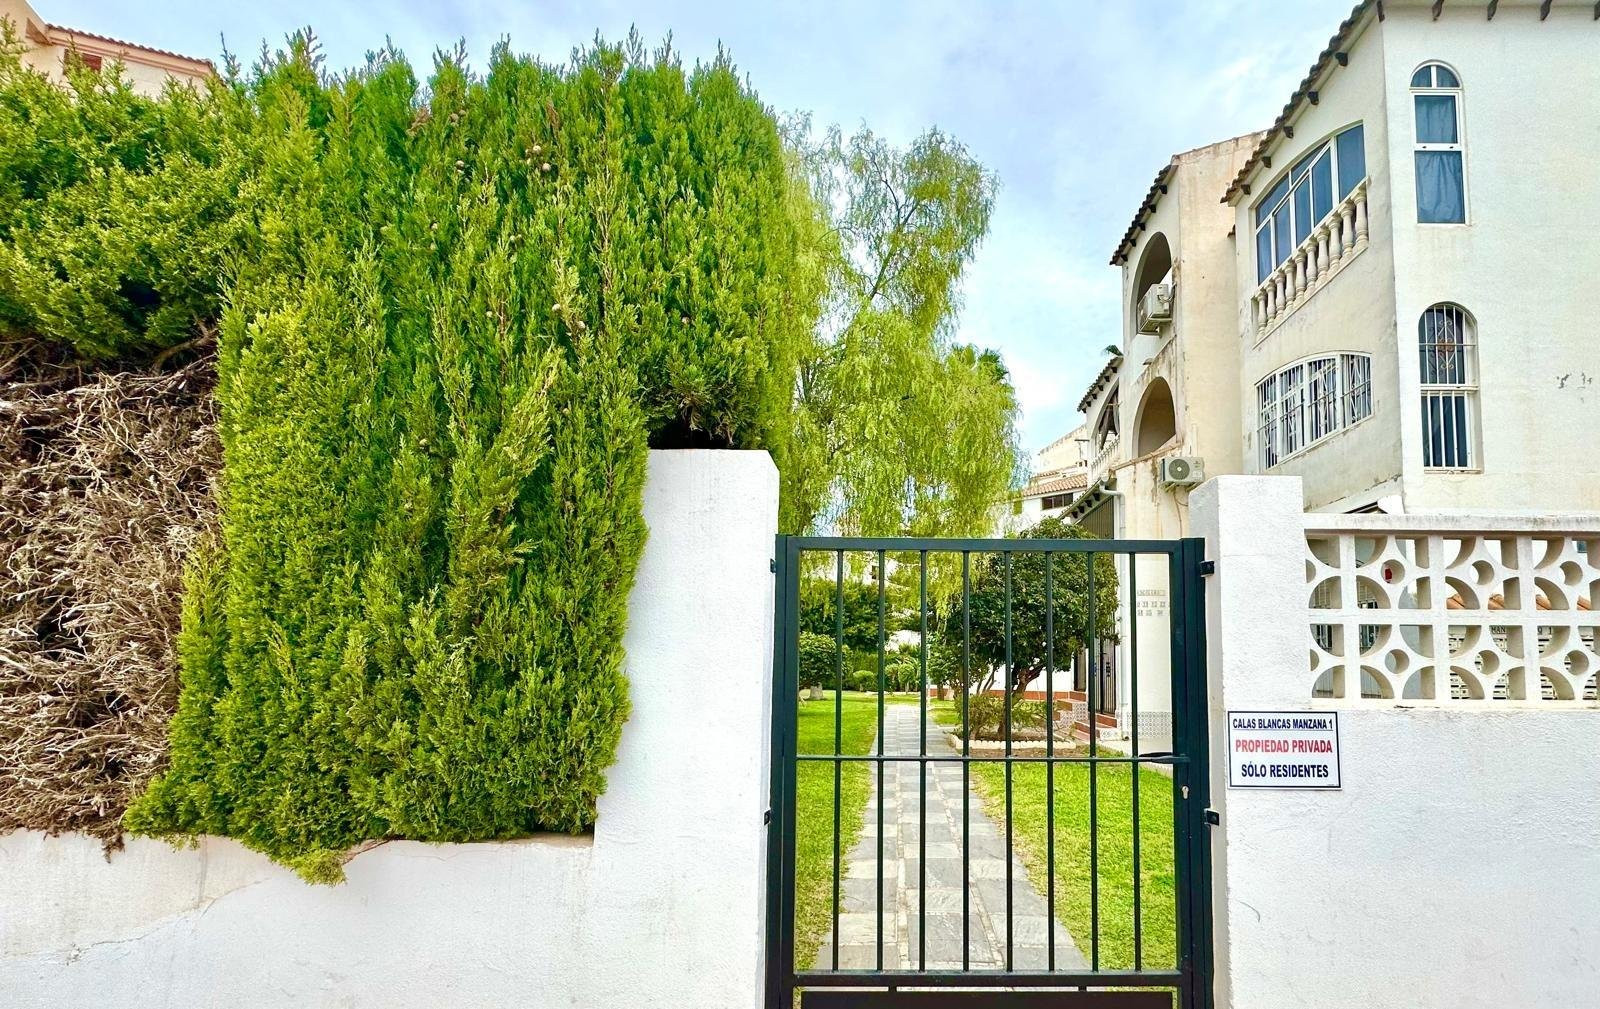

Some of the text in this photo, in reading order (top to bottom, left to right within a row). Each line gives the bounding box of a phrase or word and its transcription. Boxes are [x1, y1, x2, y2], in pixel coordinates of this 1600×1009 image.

[1233, 718, 1333, 729] CALAS BLANCAS MANZANA 1
[1235, 739, 1333, 753] PROPIEDAD PRIVADA
[1241, 761, 1329, 778] SÓLO RESIDENTES
